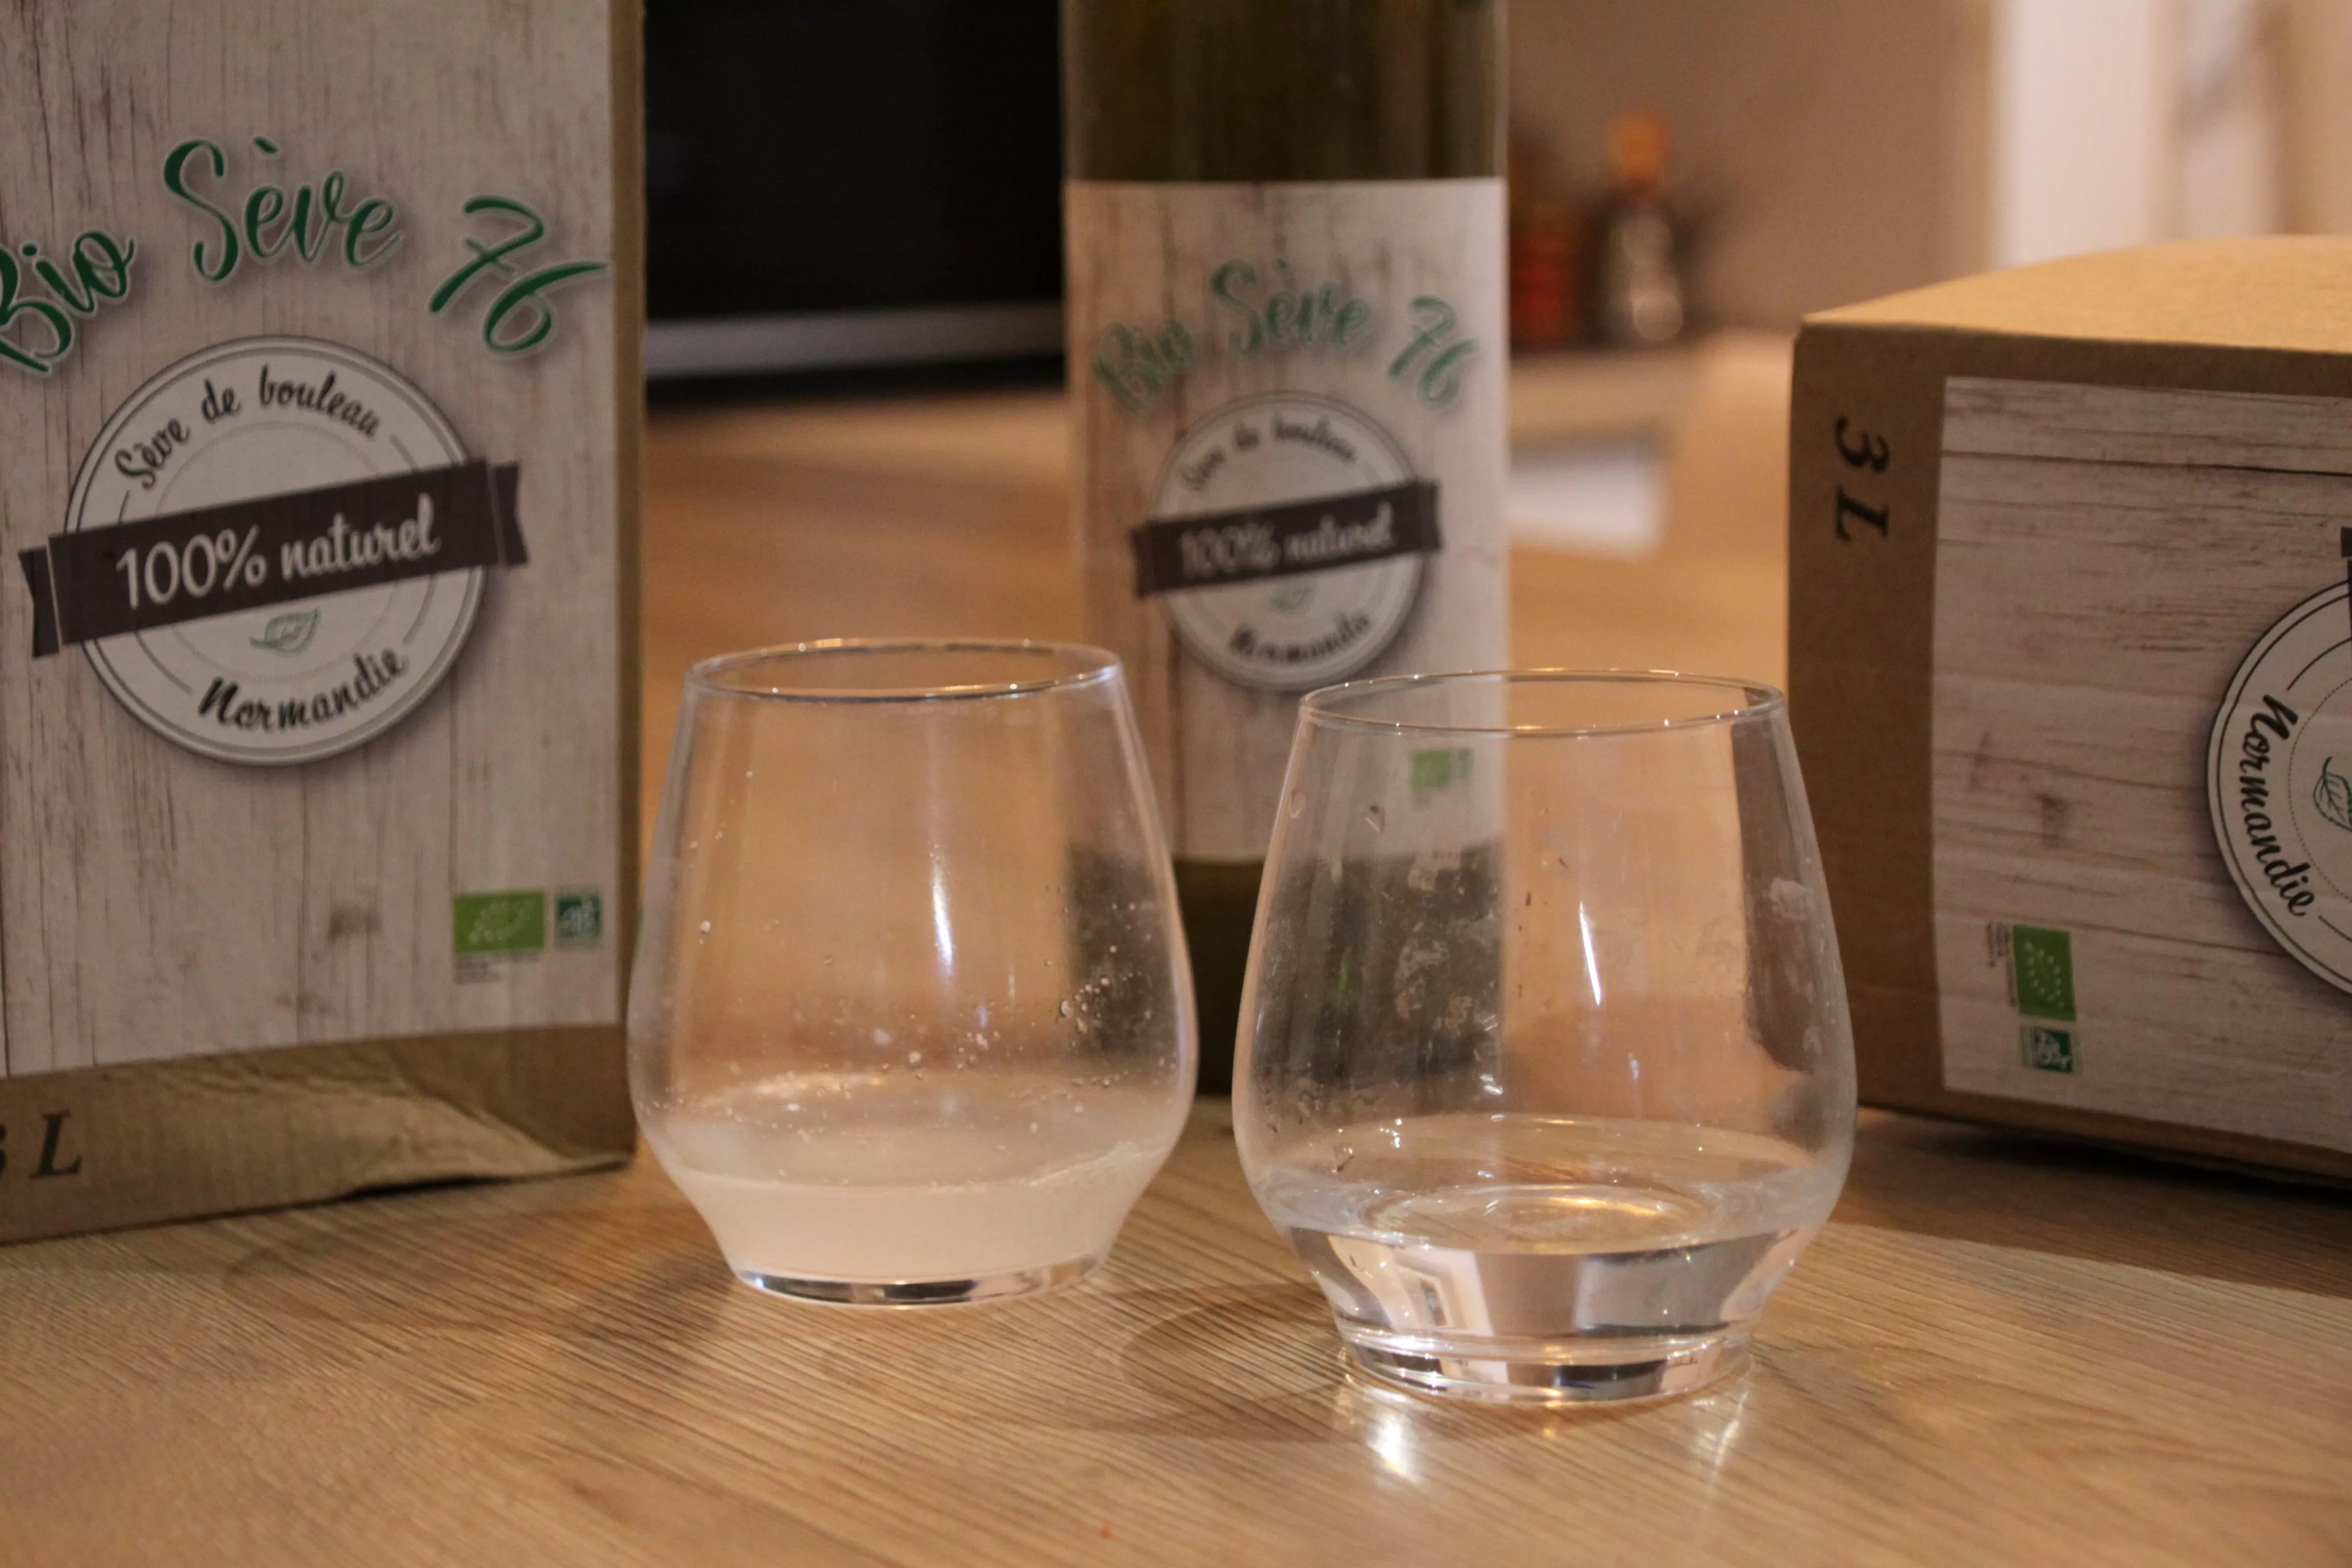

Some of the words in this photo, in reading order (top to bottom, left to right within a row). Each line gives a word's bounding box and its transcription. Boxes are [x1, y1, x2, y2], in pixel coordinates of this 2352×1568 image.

[0, 230, 135, 372] Bio
[164, 136, 402, 282] Sève
[429, 196, 609, 353] 76
[1389, 295, 1480, 409] 76
[115, 415, 191, 490] Sève
[200, 378, 242, 423] de
[258, 364, 380, 441] bouleau
[117, 524, 267, 610] 100%
[280, 492, 441, 581] naturel
[197, 646, 408, 734] Normandie
[2239, 694, 2315, 917] Normandie
